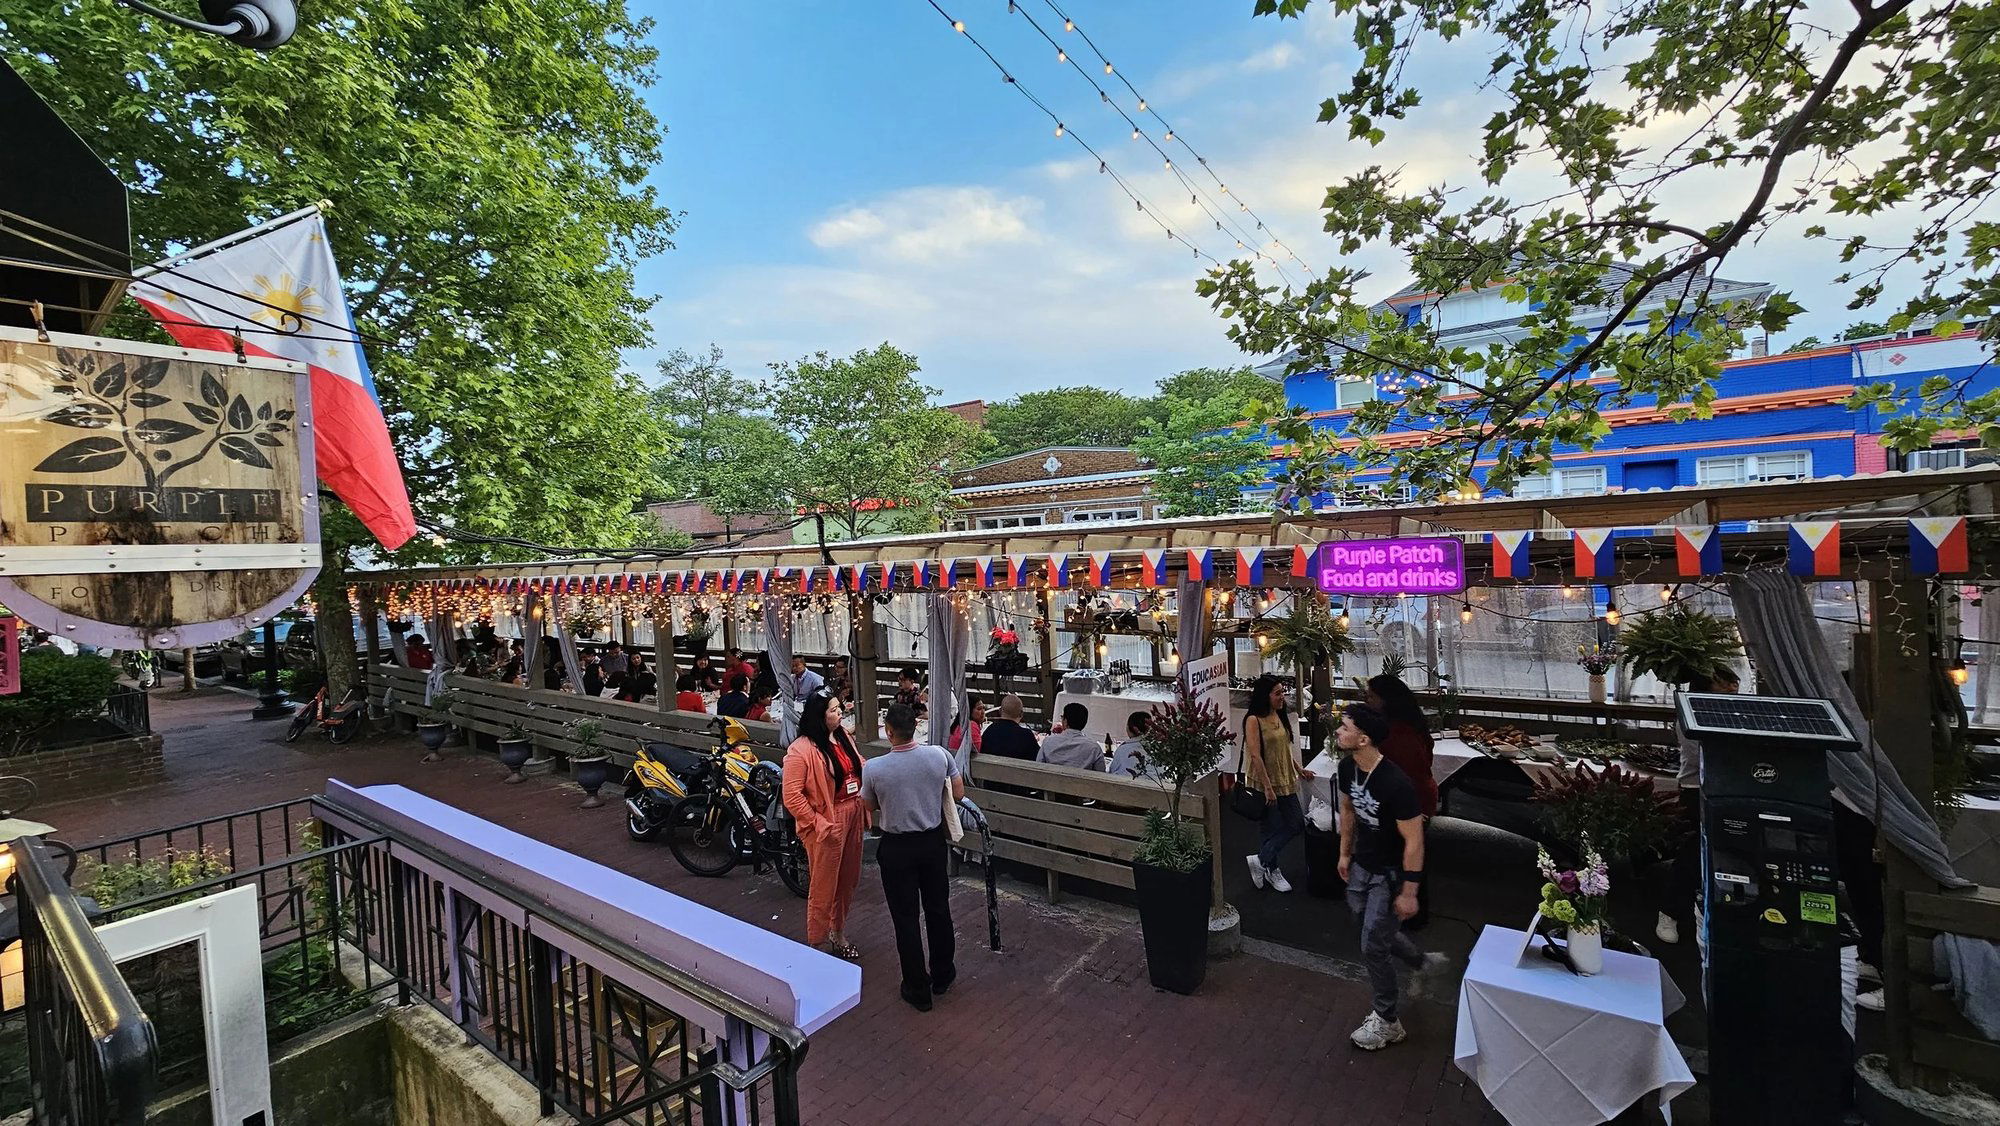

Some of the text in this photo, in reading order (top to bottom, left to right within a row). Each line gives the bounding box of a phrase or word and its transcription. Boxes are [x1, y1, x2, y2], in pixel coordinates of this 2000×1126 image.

[49, 525, 270, 543] PATCH
[1333, 544, 1444, 568] Purple Patch
[1322, 565, 1457, 588] Food and drinks
[1191, 661, 1227, 687] EDUCASIAN
